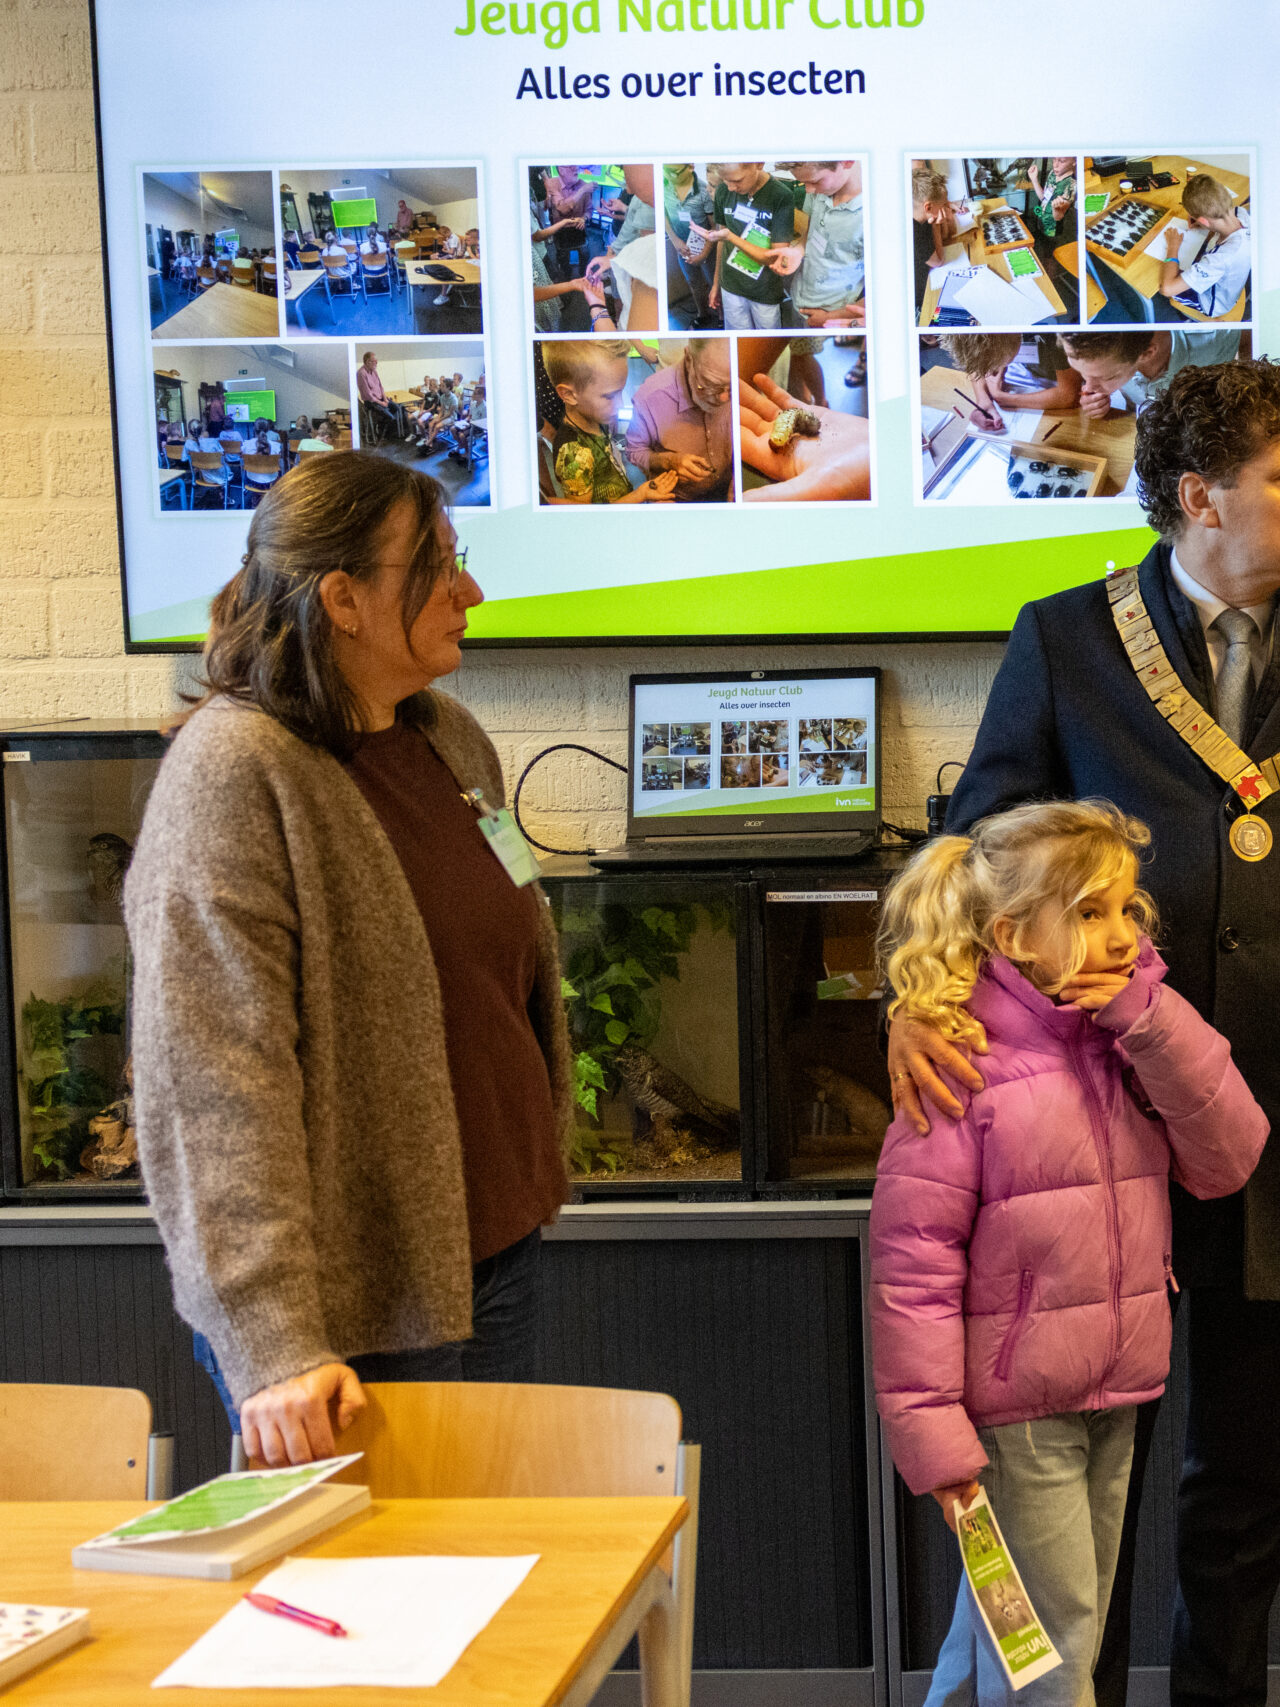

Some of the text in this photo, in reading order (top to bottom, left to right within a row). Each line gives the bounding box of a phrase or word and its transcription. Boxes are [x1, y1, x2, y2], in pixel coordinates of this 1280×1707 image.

[454, 0, 925, 49] Jeugd Natuur Club
[516, 61, 866, 100] Alles over insecten
[707, 685, 803, 699] Jeugd Natuur Club
[719, 702, 739, 710] Alles
